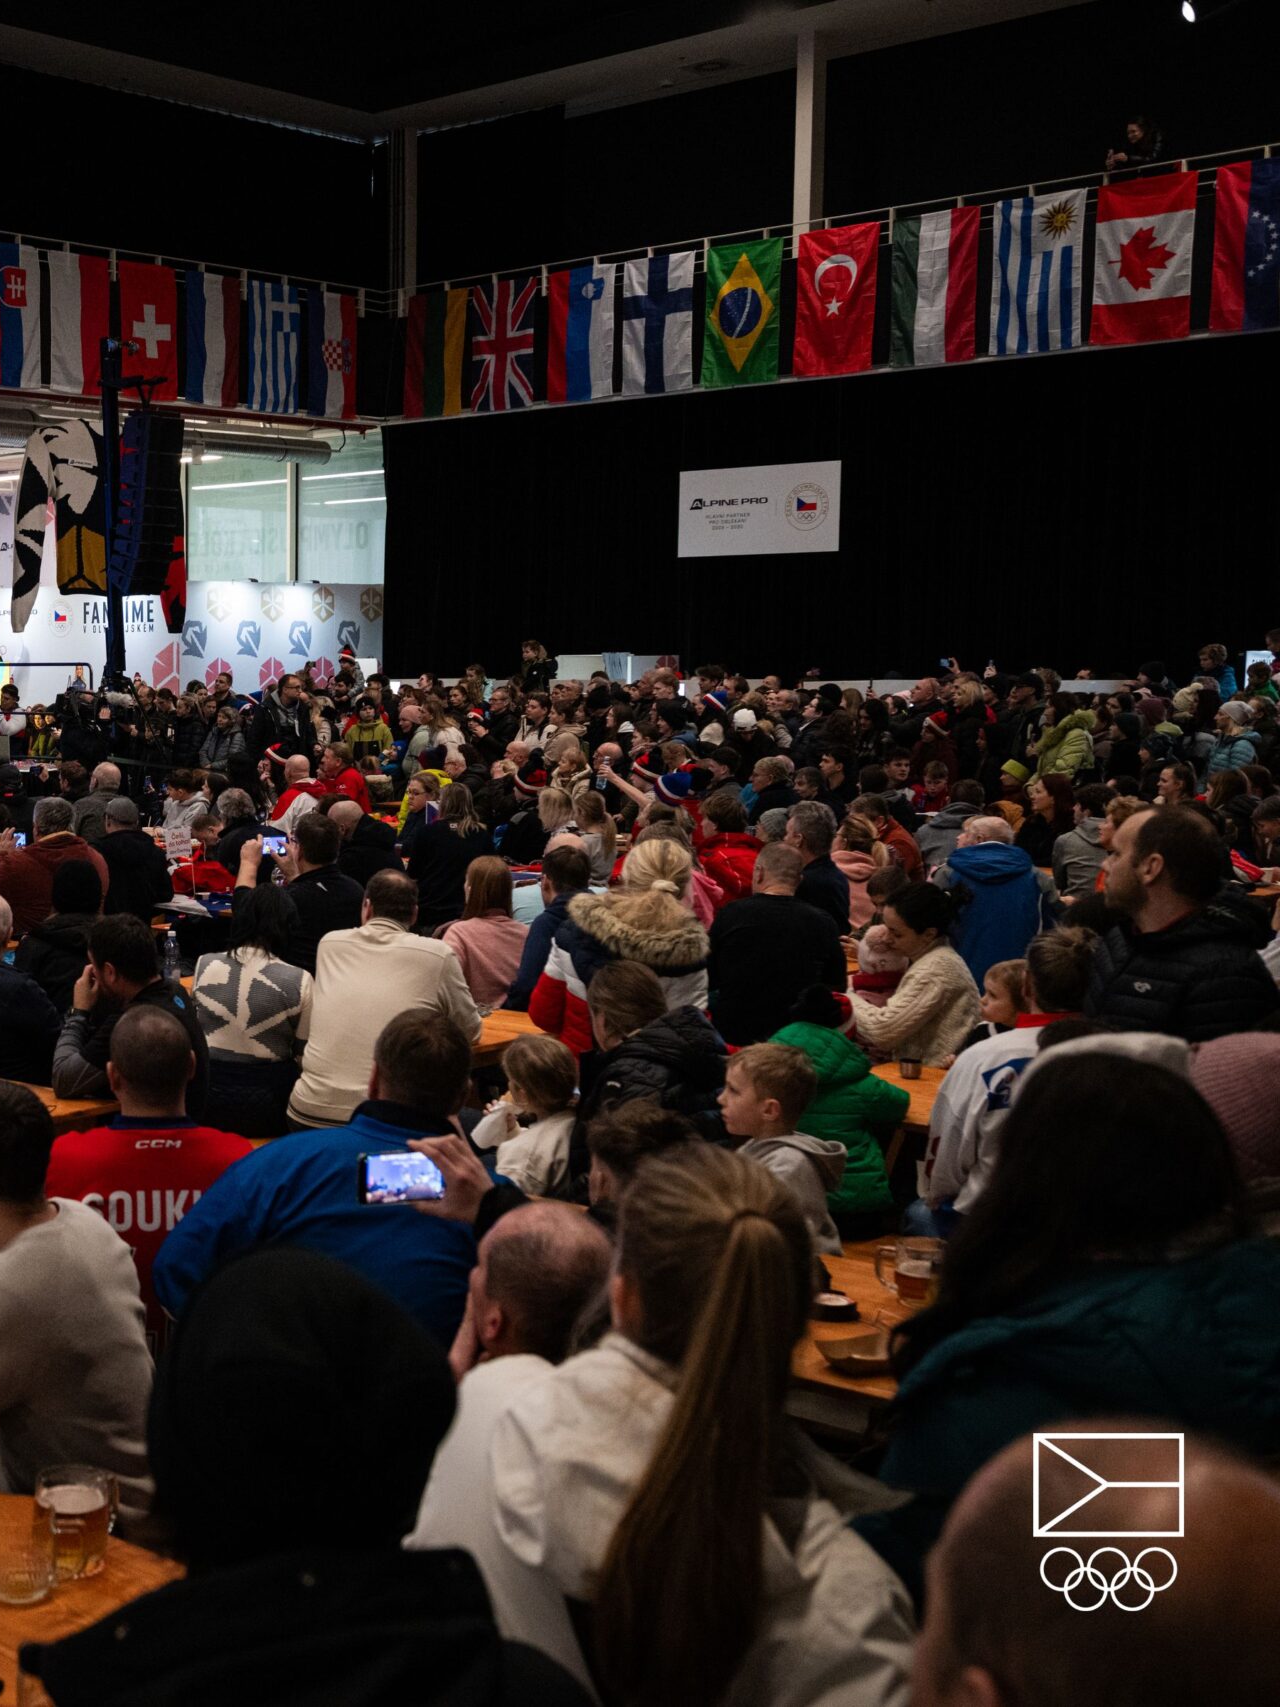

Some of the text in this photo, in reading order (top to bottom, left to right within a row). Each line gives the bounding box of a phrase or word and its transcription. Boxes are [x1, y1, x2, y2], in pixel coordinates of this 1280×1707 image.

[689, 496, 769, 511] ALPINE PRO
[83, 596, 154, 624] FANÍME
[82, 622, 154, 634] V OLYJSKÉM
[135, 1139, 182, 1149] CCM
